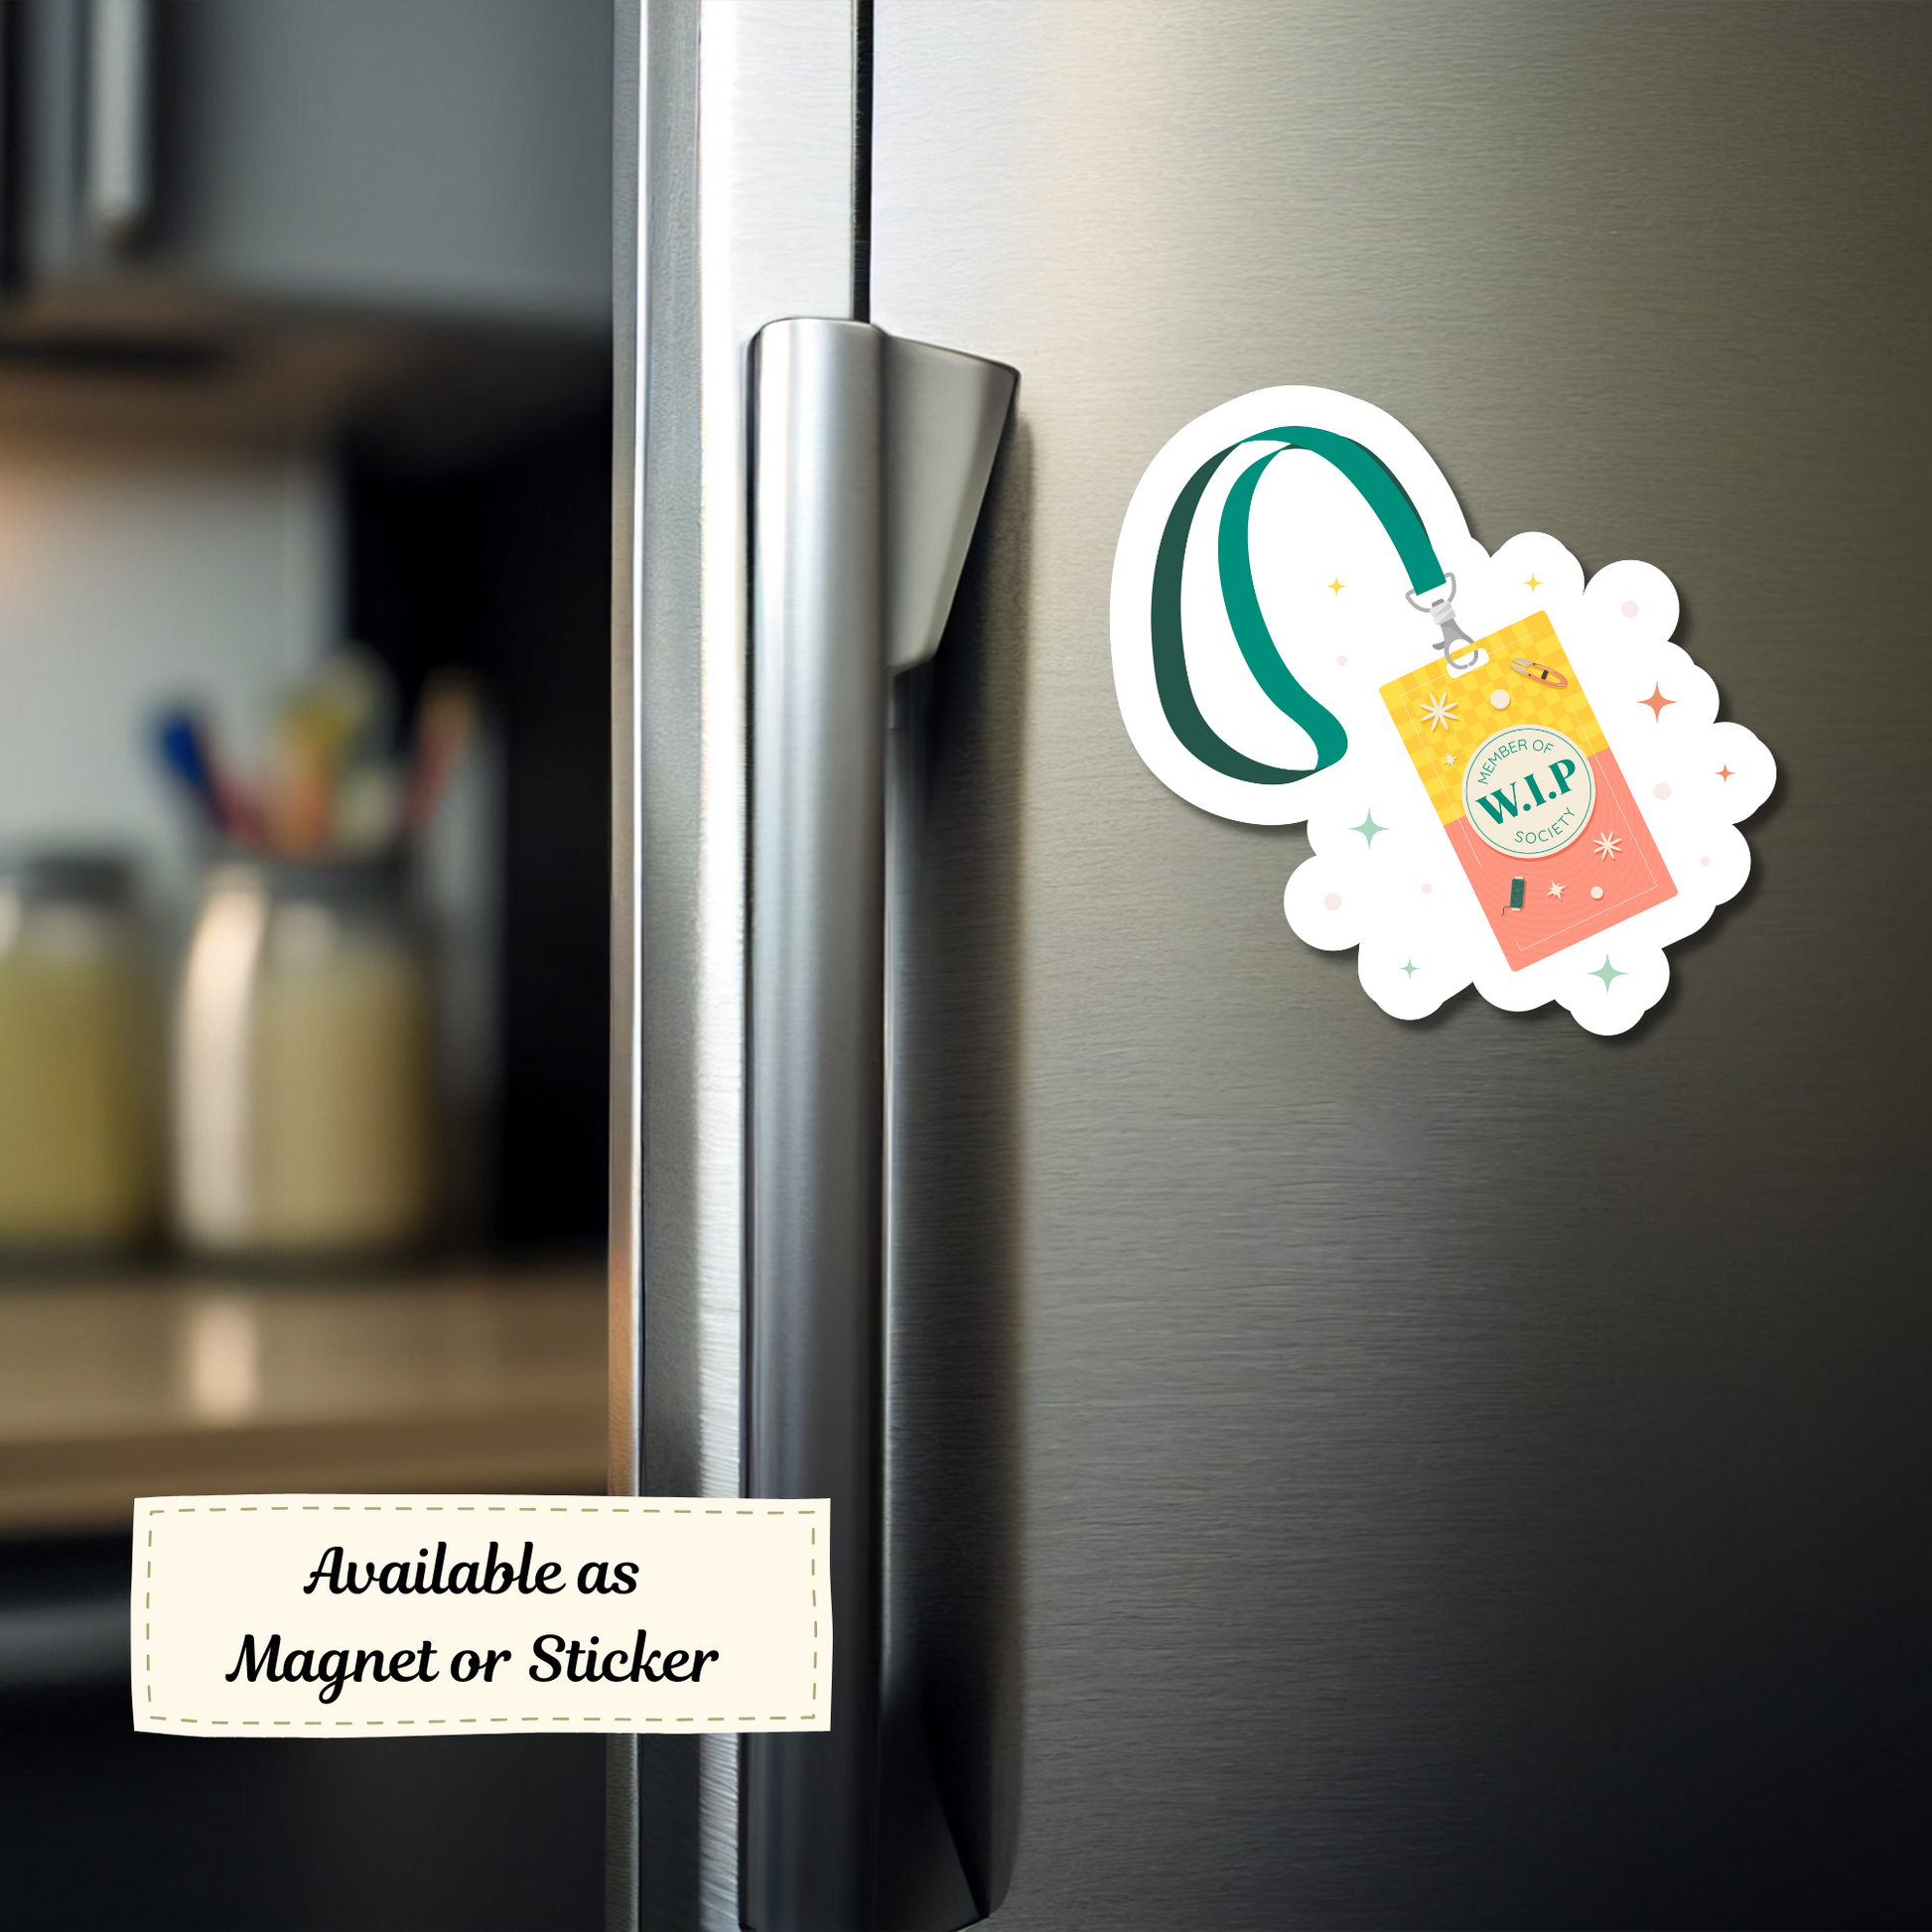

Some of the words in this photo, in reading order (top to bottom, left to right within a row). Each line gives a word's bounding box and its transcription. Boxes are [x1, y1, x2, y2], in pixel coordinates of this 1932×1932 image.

[1477, 739, 1528, 785] MEMBER
[1532, 739, 1555, 754] OF
[1474, 759, 1577, 825] W.I.P
[1514, 806, 1576, 844] SOCIETY
